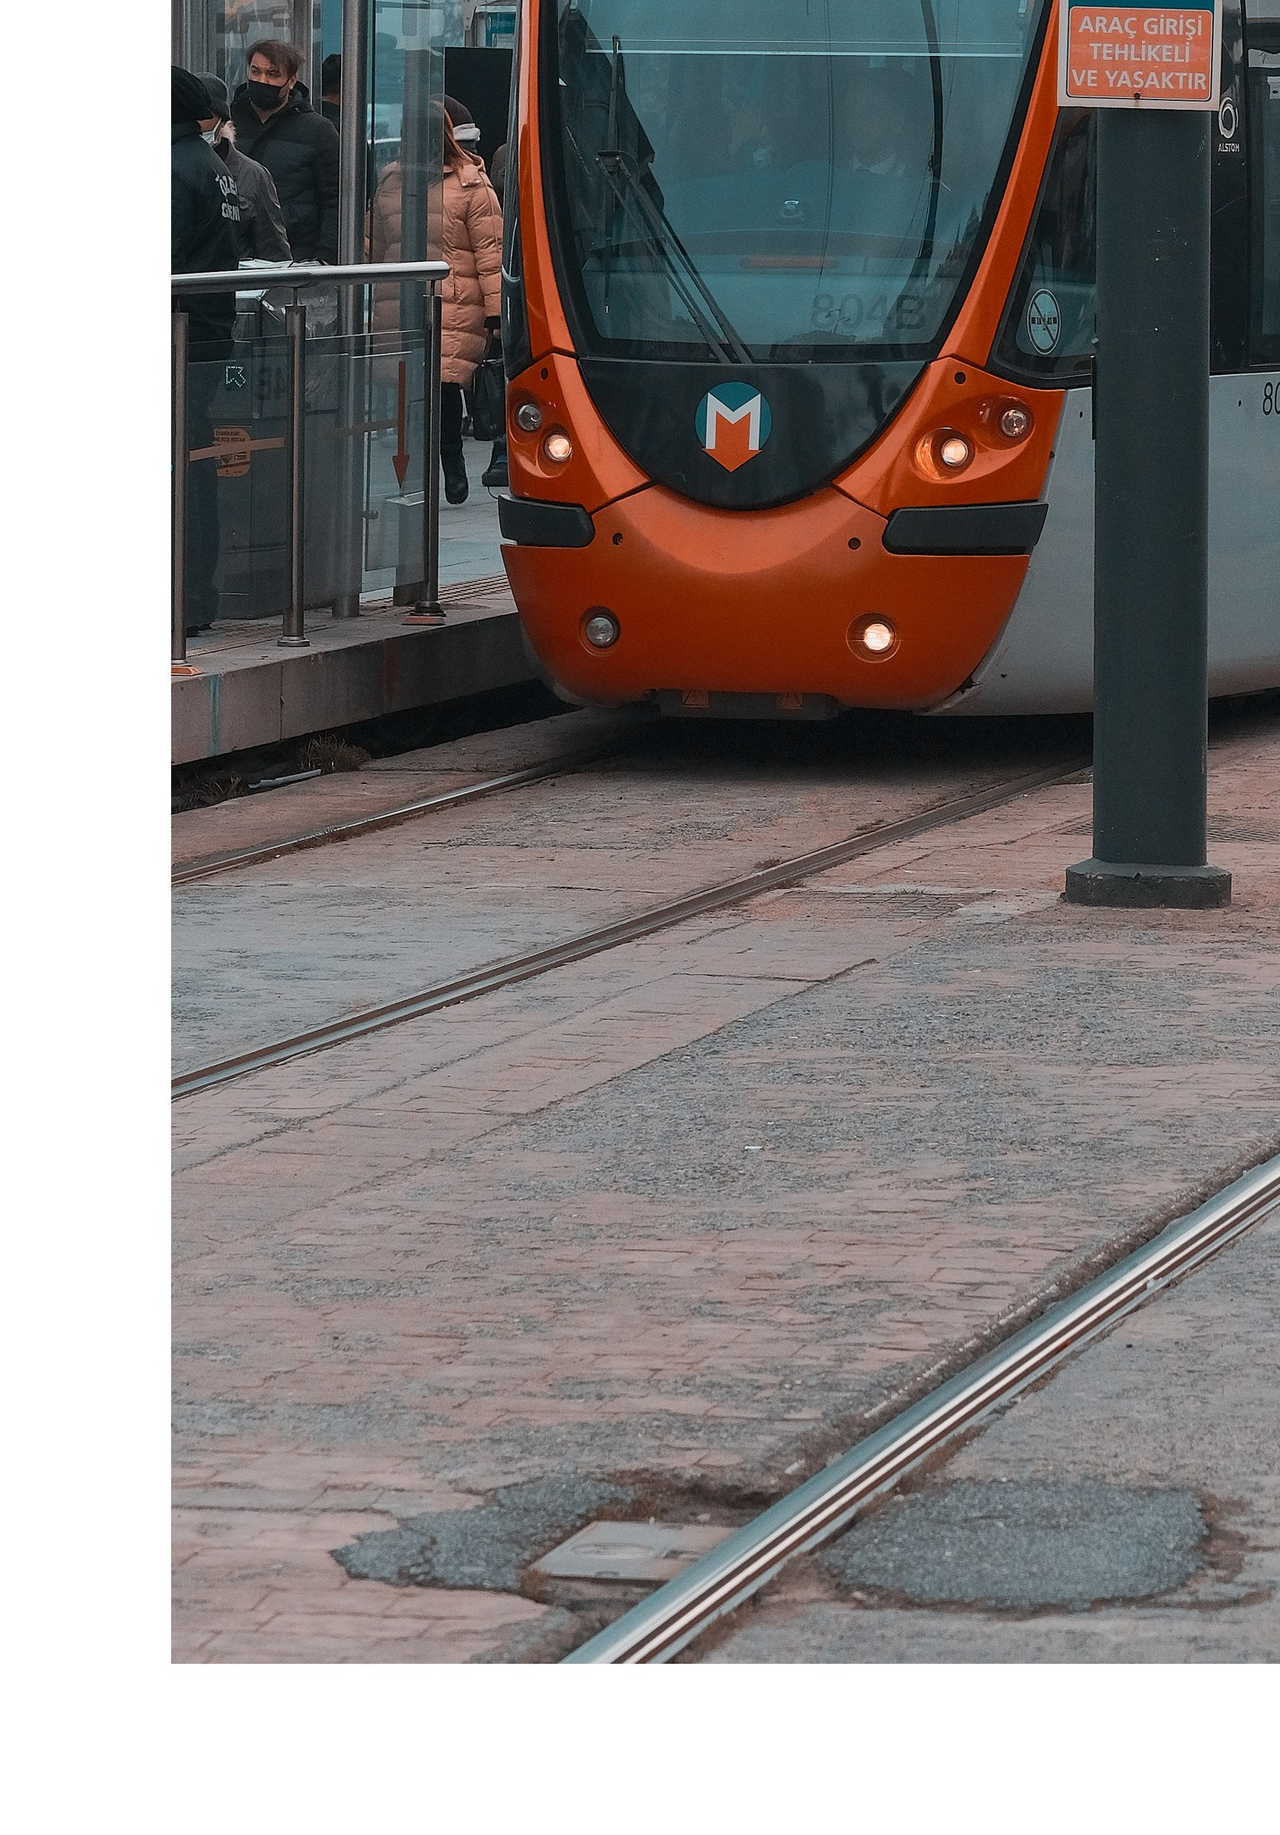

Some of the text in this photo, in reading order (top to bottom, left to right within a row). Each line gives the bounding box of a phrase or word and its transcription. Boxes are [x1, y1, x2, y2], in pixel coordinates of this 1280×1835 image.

[1078, 14, 1202, 41] ARAÇ GİRİŞİ
[1089, 40, 1191, 63] TEHLİKELİ
[1071, 69, 1207, 90] VE YASAKTIR
[1218, 142, 1240, 153] ALSTOM
[811, 293, 926, 330] 804B
